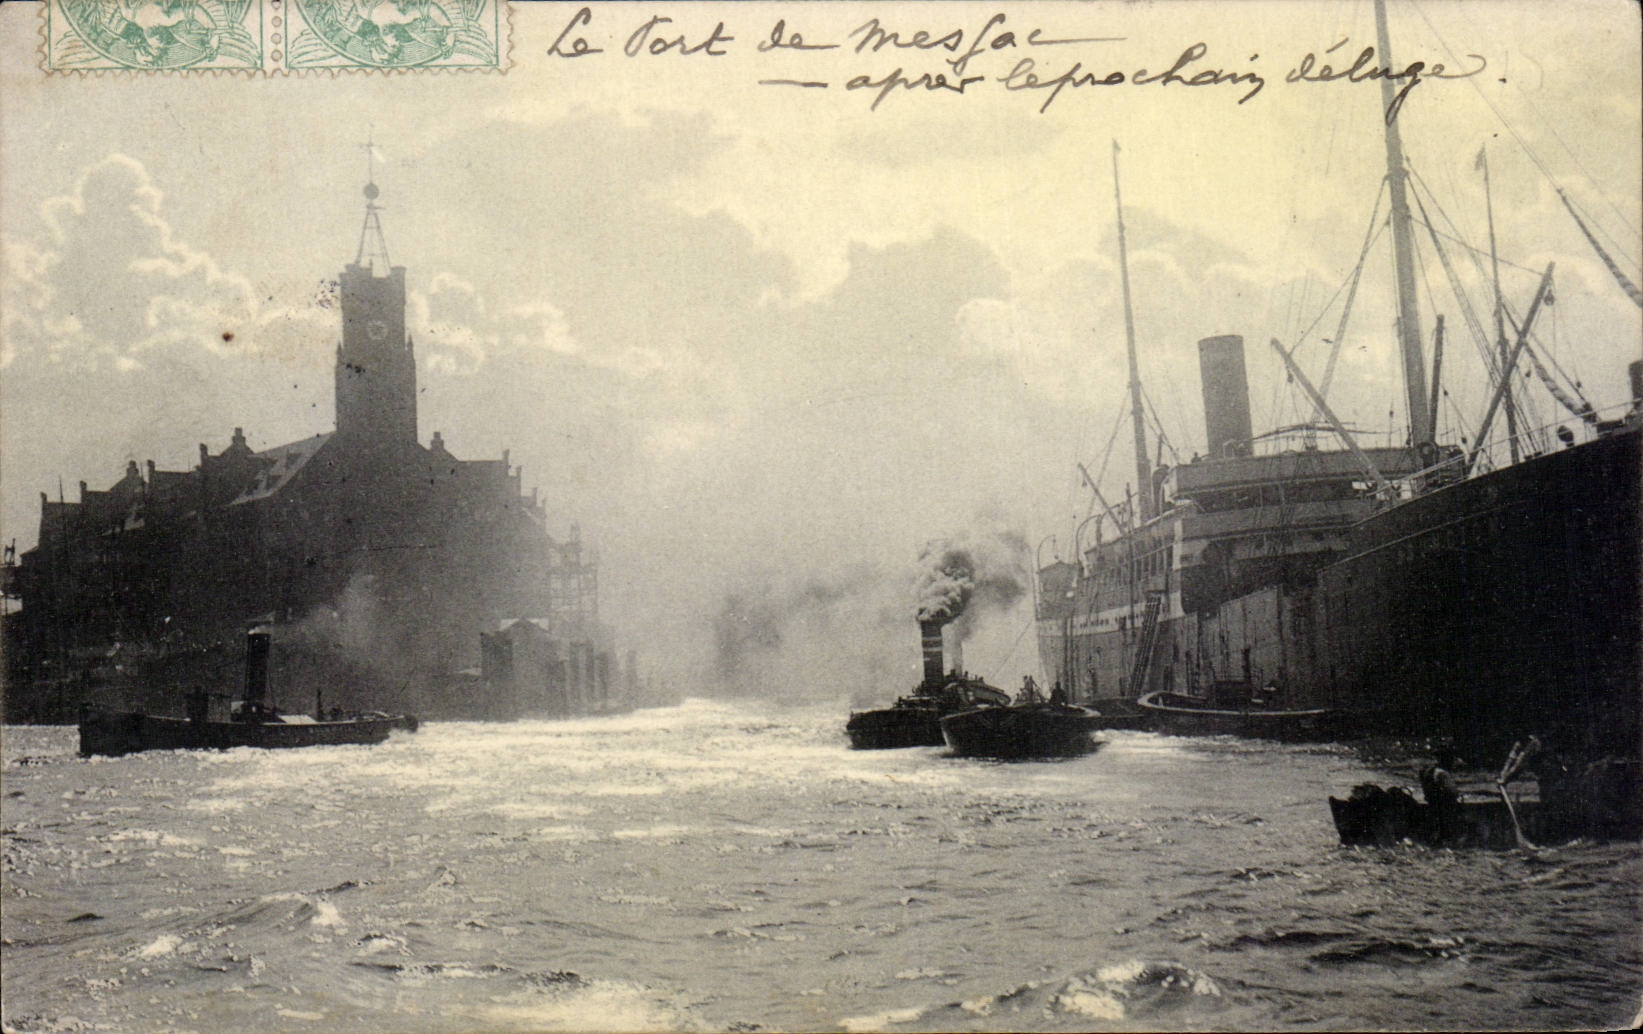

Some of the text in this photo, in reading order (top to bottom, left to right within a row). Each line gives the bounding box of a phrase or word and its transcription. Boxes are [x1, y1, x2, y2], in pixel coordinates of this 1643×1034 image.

[547, 7, 604, 58] Le
[624, 15, 735, 57] Port
[757, 19, 841, 52] de
